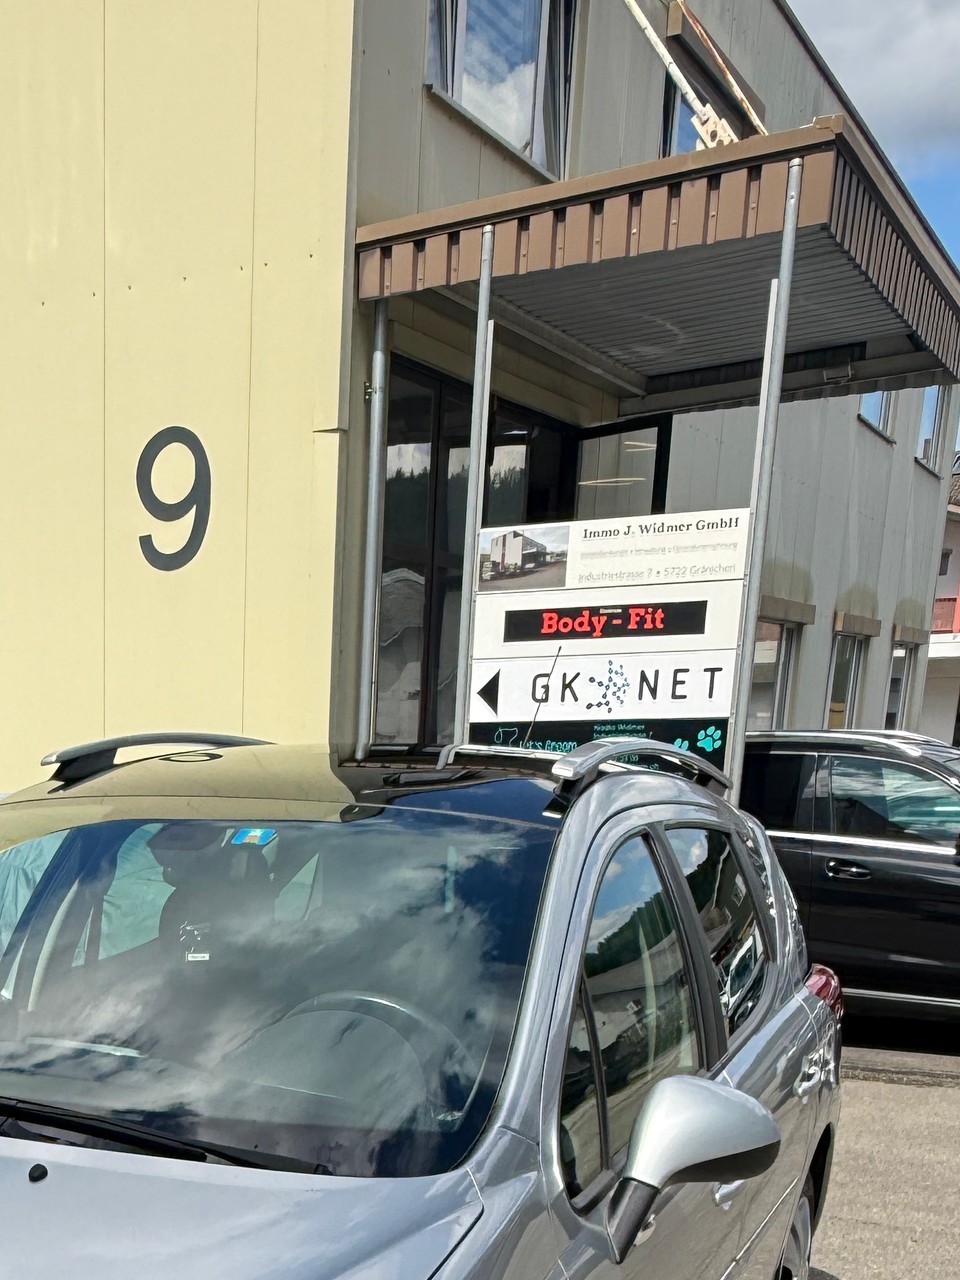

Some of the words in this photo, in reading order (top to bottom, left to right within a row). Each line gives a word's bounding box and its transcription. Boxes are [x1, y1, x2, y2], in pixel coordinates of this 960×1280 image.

[136, 425, 212, 572] 9
[583, 528, 620, 539] Immo
[639, 522, 693, 535] Widmer
[695, 517, 740, 531] GmbH
[637, 667, 724, 701] NET
